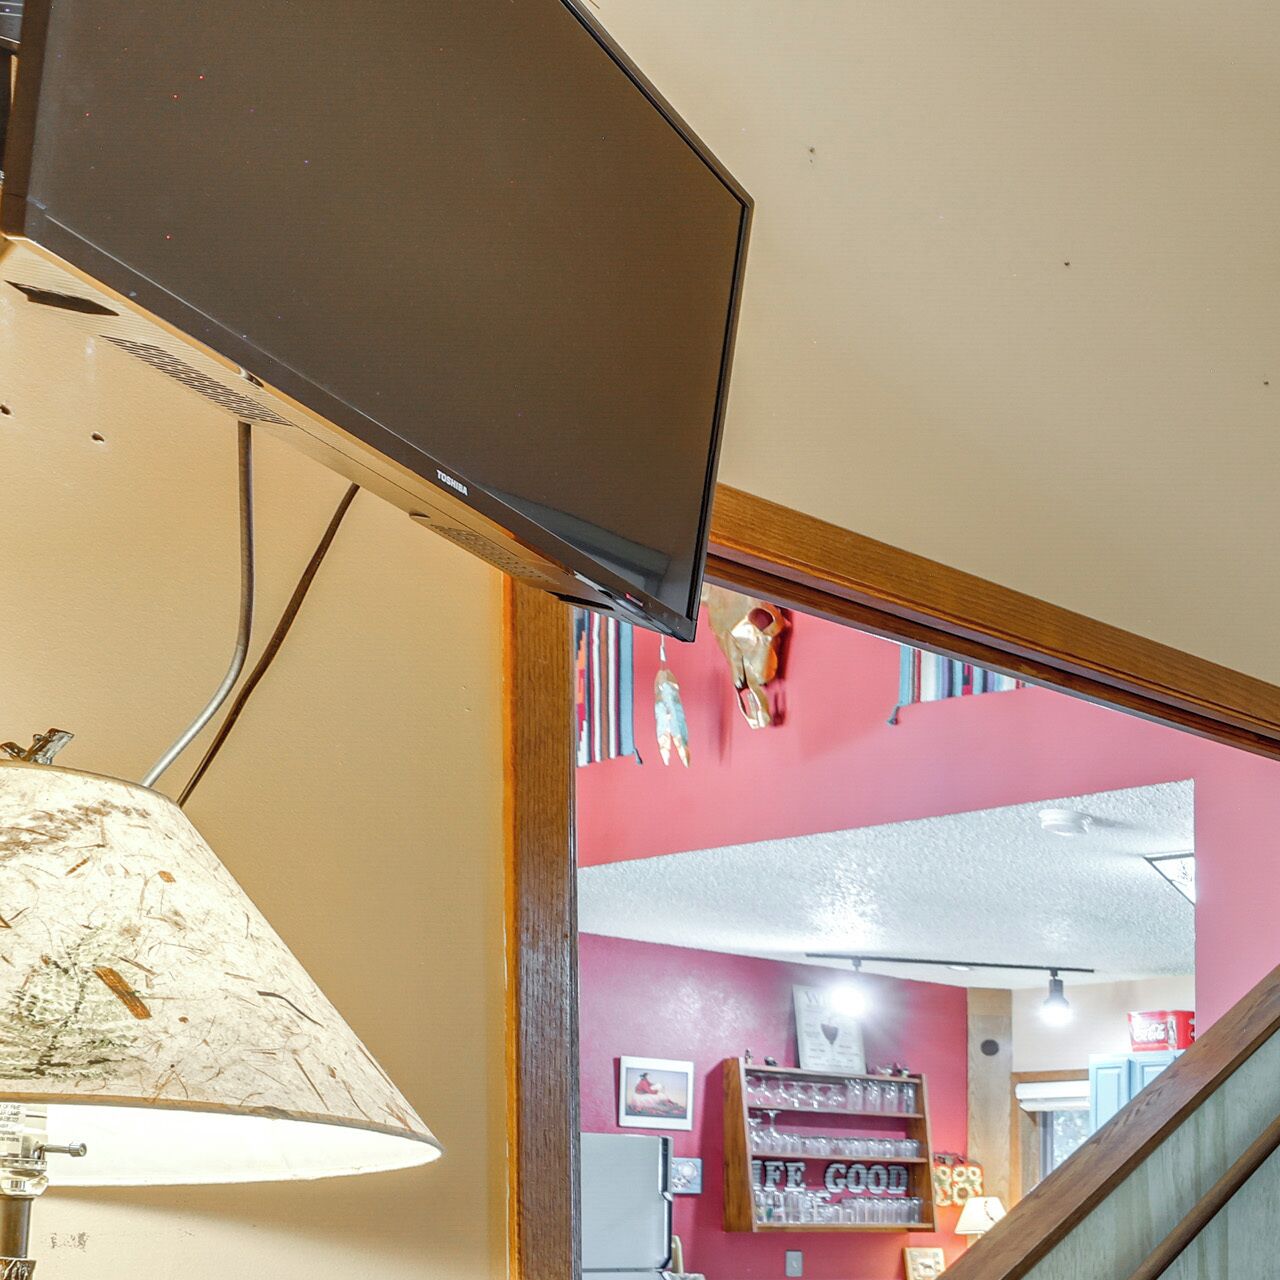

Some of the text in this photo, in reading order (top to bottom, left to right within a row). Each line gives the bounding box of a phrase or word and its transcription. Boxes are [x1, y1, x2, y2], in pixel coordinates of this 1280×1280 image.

[436, 469, 468, 496] TOSHIBA
[752, 1160, 908, 1194] IFE GOOD
